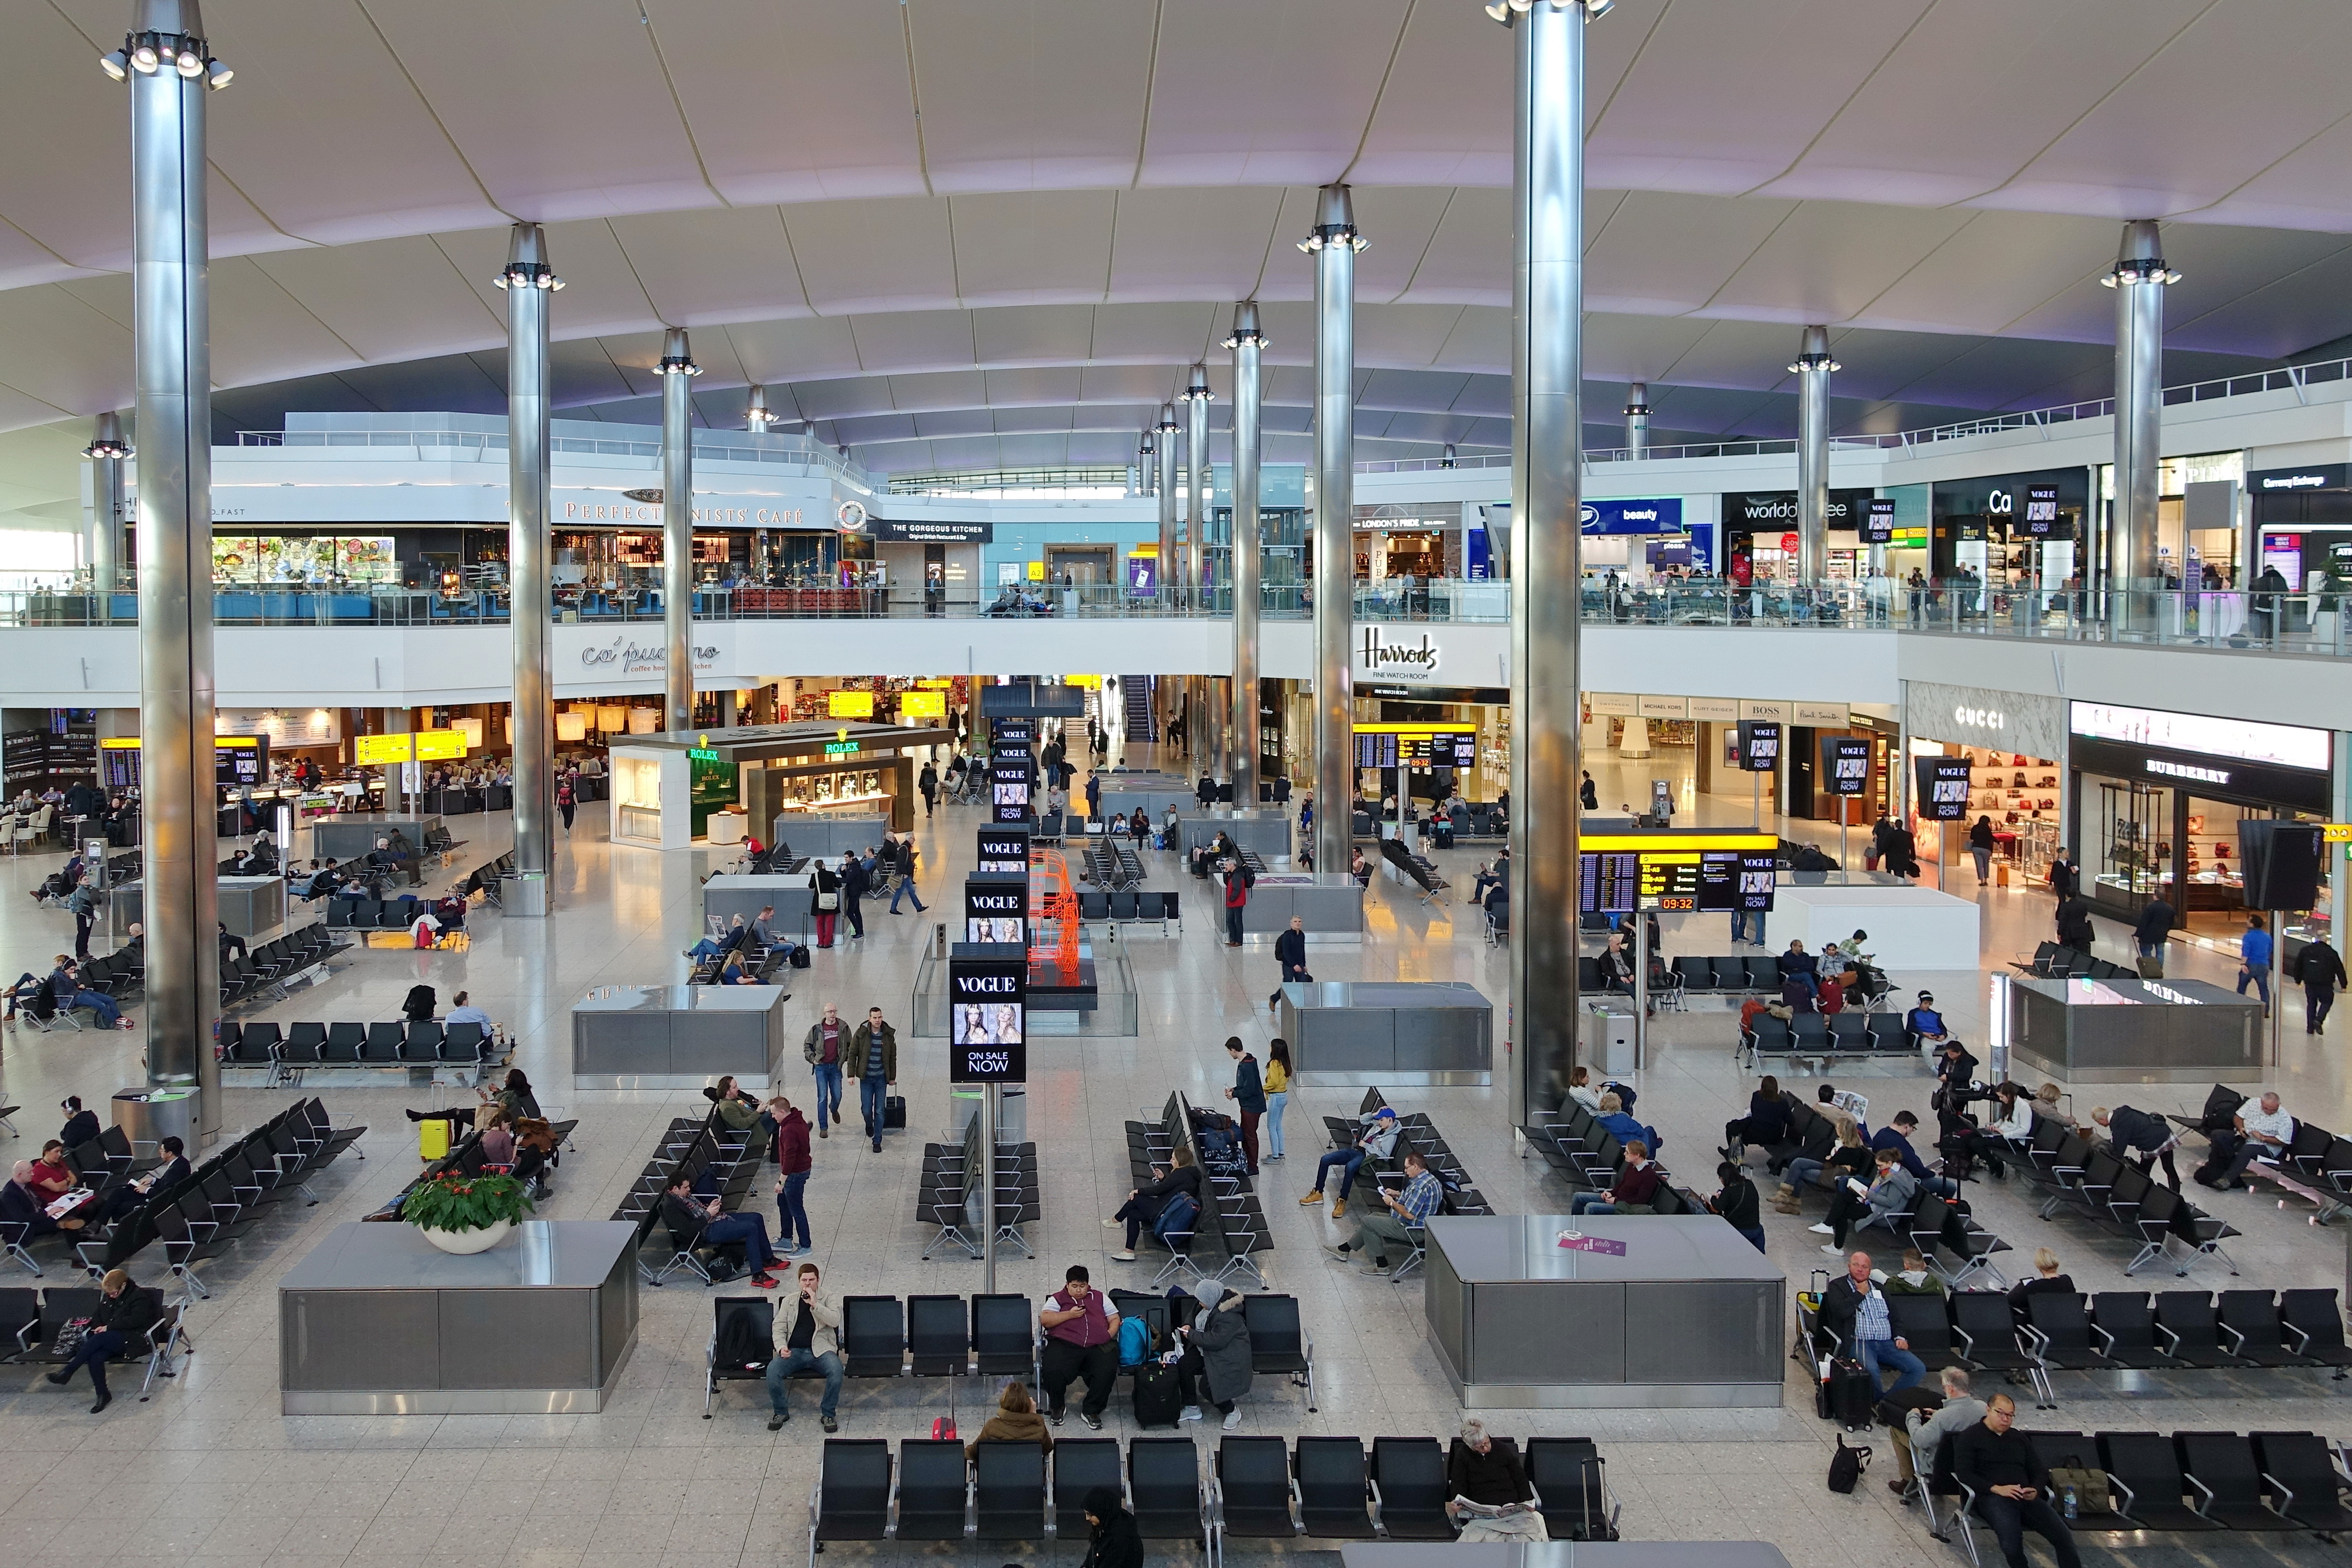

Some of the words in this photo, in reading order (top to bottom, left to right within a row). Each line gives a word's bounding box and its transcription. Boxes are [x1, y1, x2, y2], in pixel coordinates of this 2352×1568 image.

[2263, 477, 2293, 489] Currency
[2293, 475, 2324, 486] Exchange
[565, 502, 749, 522] PERFECTNISTS'
[757, 508, 803, 523] CAFÉ
[1623, 510, 1657, 521] beauty
[909, 524, 950, 533] GORGEOUS
[1362, 520, 1398, 528] LONDON'S
[1663, 542, 1686, 550] please
[1357, 627, 1436, 670] Harrods
[1752, 706, 1780, 715] BOSS
[1800, 710, 1816, 718] Paul
[1818, 711, 1842, 720] Smith
[1955, 706, 2003, 729] GUCCI
[826, 741, 858, 754] ROLEX
[1001, 749, 1027, 757] VOGUE
[690, 748, 718, 761] ROLEX
[996, 770, 1025, 778] VOGUE
[1939, 767, 1967, 776] VOGUE
[2146, 760, 2230, 784] BURBERRY
[983, 843, 1022, 854] VOGUE
[1743, 858, 1772, 867] VOGUE
[971, 896, 1018, 909] VOGUE
[1663, 899, 1693, 909] 09:32
[958, 977, 1015, 992] VOGUE
[968, 1052, 984, 1060] ON
[968, 1060, 1008, 1072] NOW
